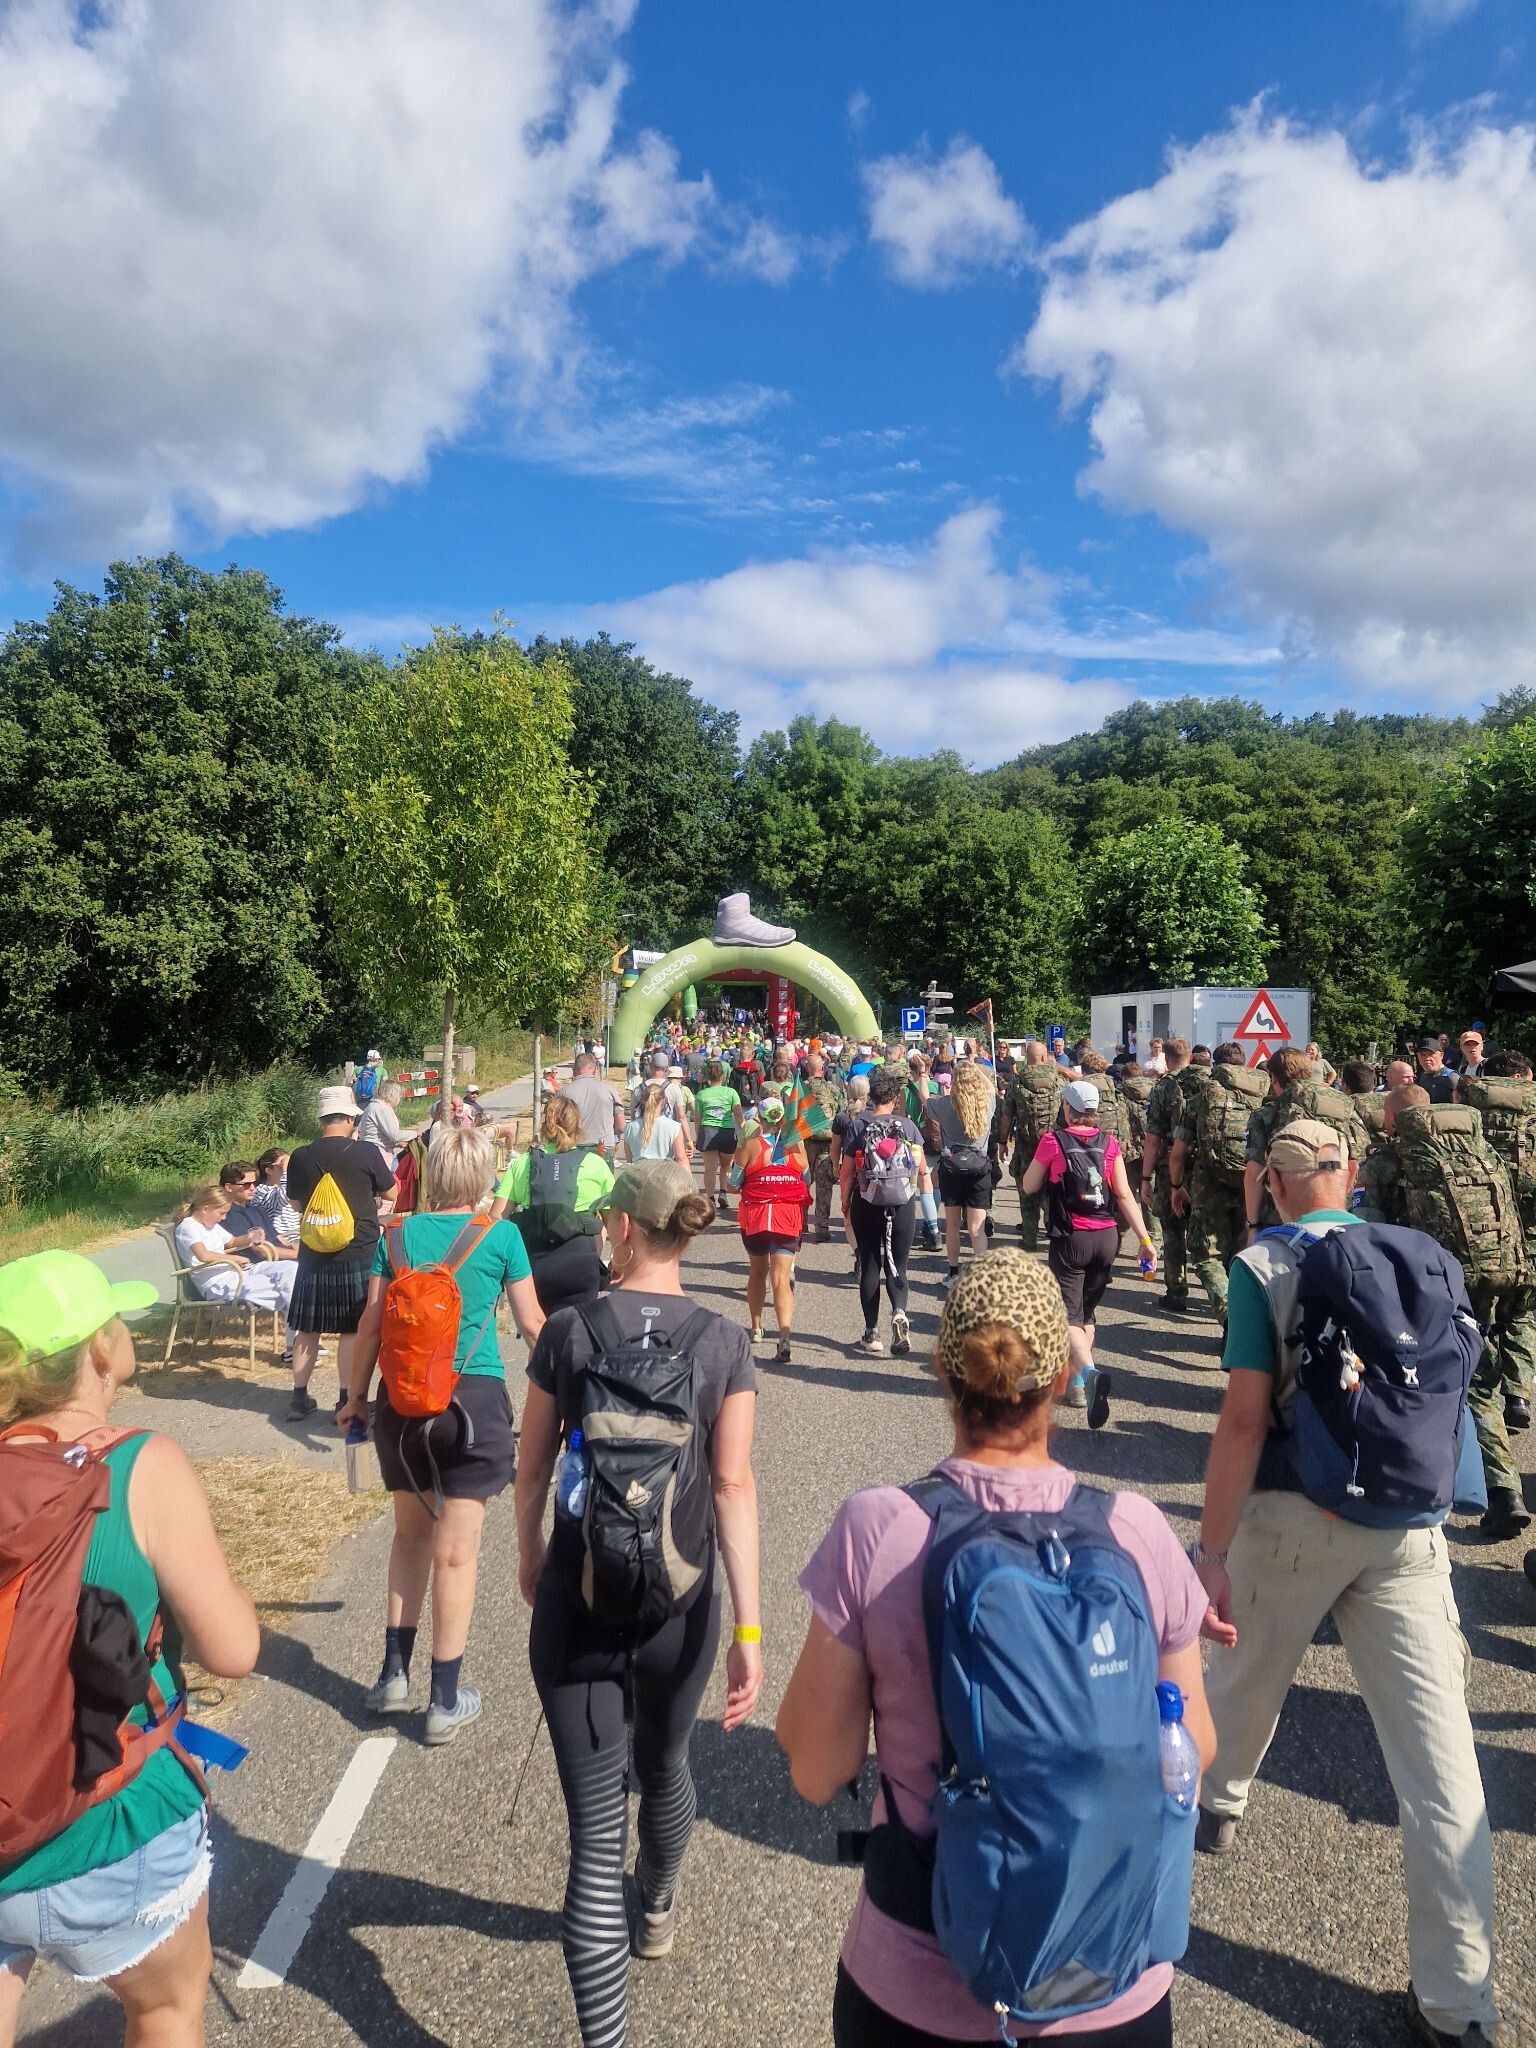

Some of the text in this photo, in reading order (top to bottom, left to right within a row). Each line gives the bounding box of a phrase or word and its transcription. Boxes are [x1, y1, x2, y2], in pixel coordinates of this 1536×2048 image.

[641, 954, 697, 996] LOWA
[807, 959, 857, 1006] LOWA
[906, 1011, 920, 1029] P
[1053, 1026, 1061, 1037] P
[306, 1214, 343, 1226] JUMBO
[1089, 1660, 1129, 1678] deuter
